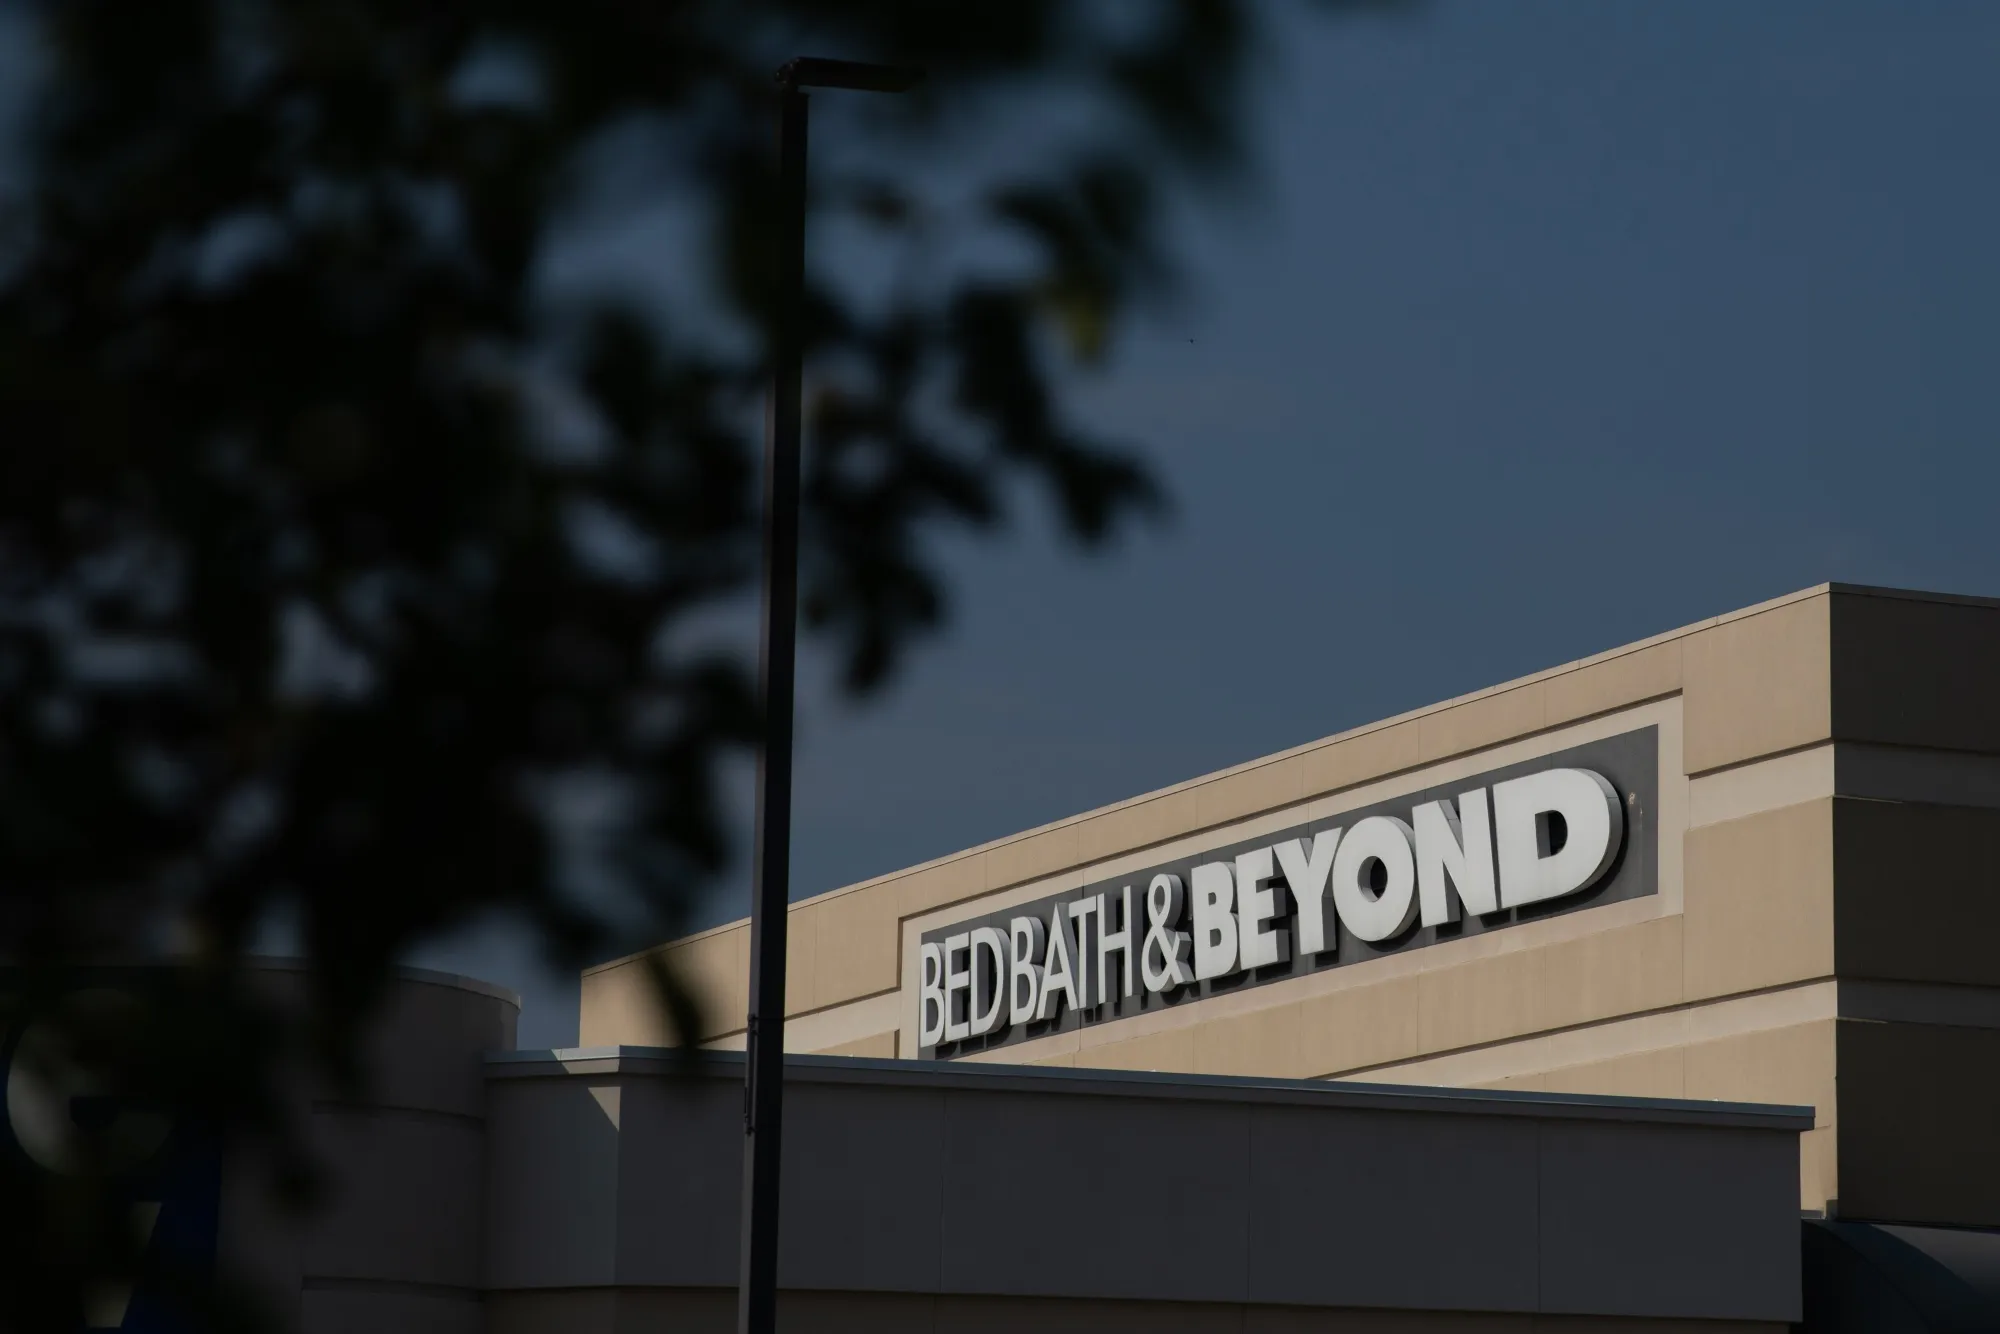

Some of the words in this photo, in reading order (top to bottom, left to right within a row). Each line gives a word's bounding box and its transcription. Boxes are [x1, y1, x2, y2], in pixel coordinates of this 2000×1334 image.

[919, 926, 1009, 1047] BED
[1010, 885, 1134, 1026] BATH
[1141, 873, 1193, 992] &
[1191, 768, 1618, 981] BEYOND
